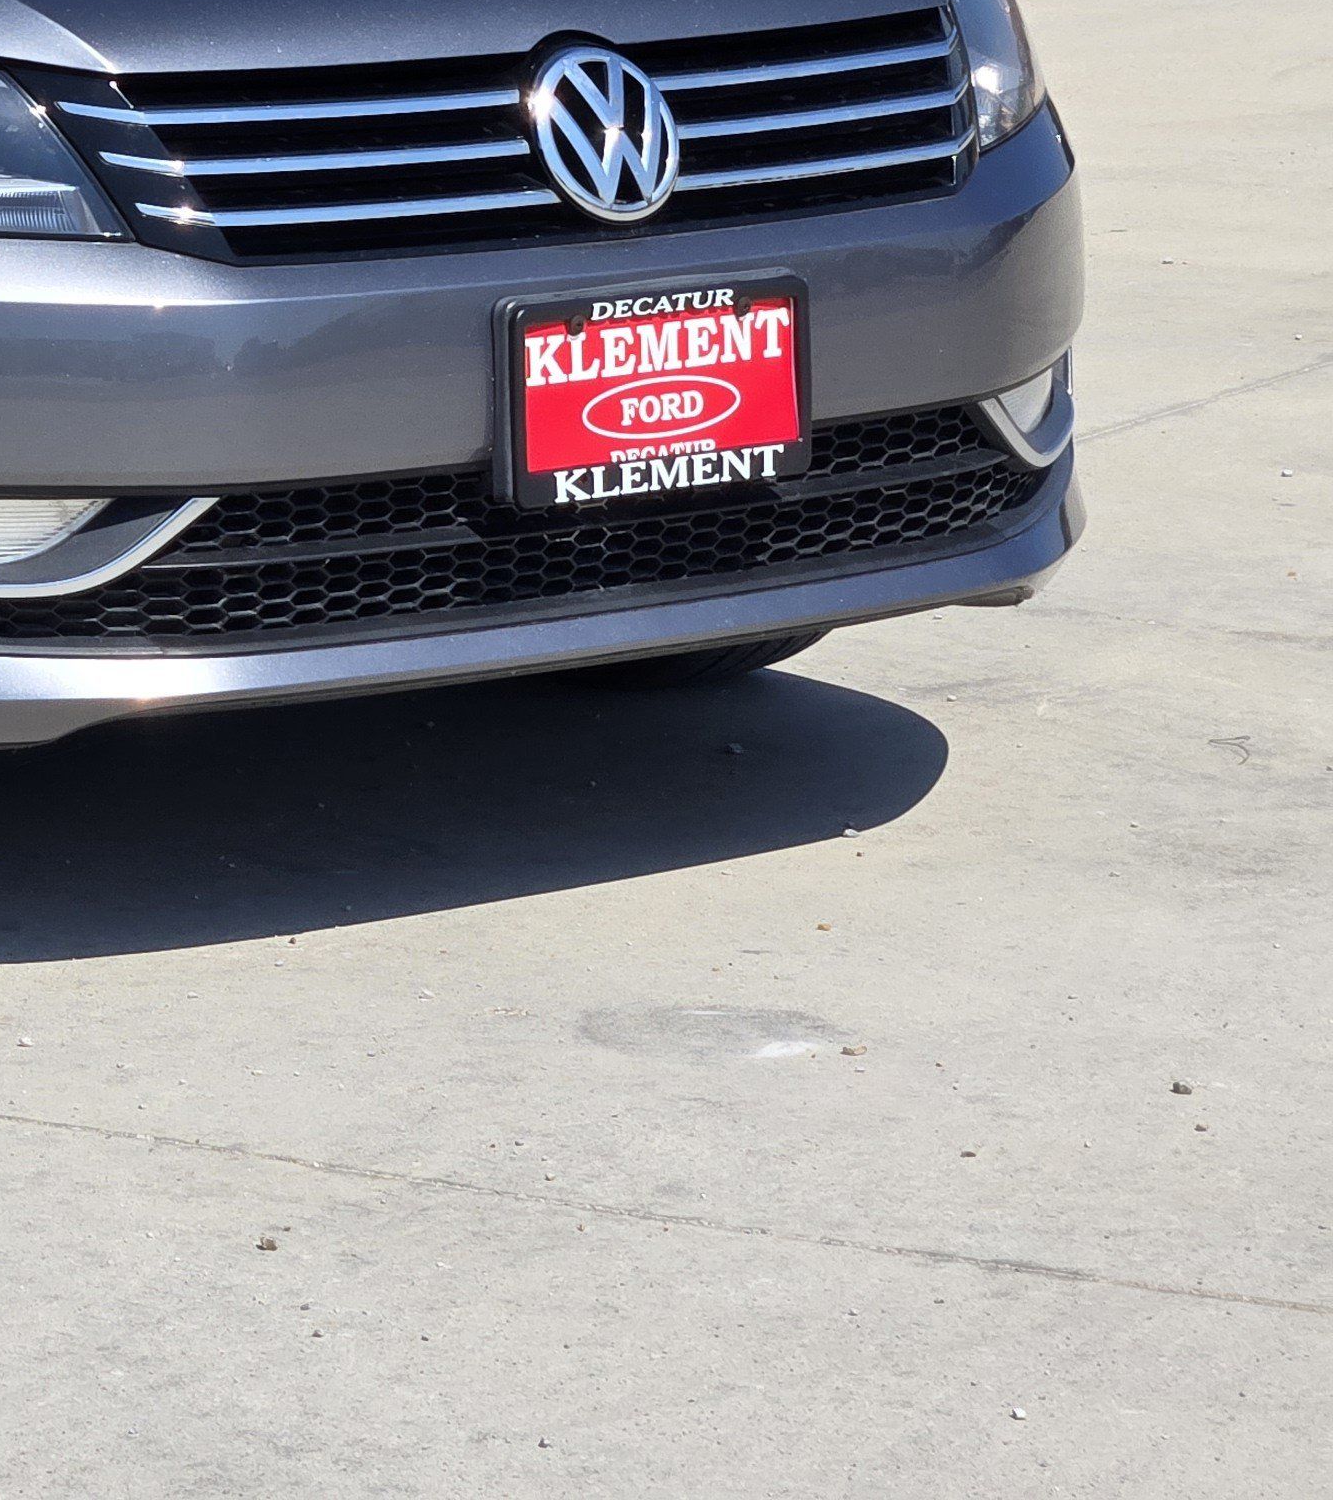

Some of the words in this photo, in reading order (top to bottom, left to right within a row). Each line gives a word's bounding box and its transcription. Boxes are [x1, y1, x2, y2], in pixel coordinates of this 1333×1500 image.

[590, 288, 734, 321] DECATUR
[524, 306, 790, 387] KLEMENT
[619, 389, 705, 427] FORD
[553, 443, 785, 504] KLEMENT
